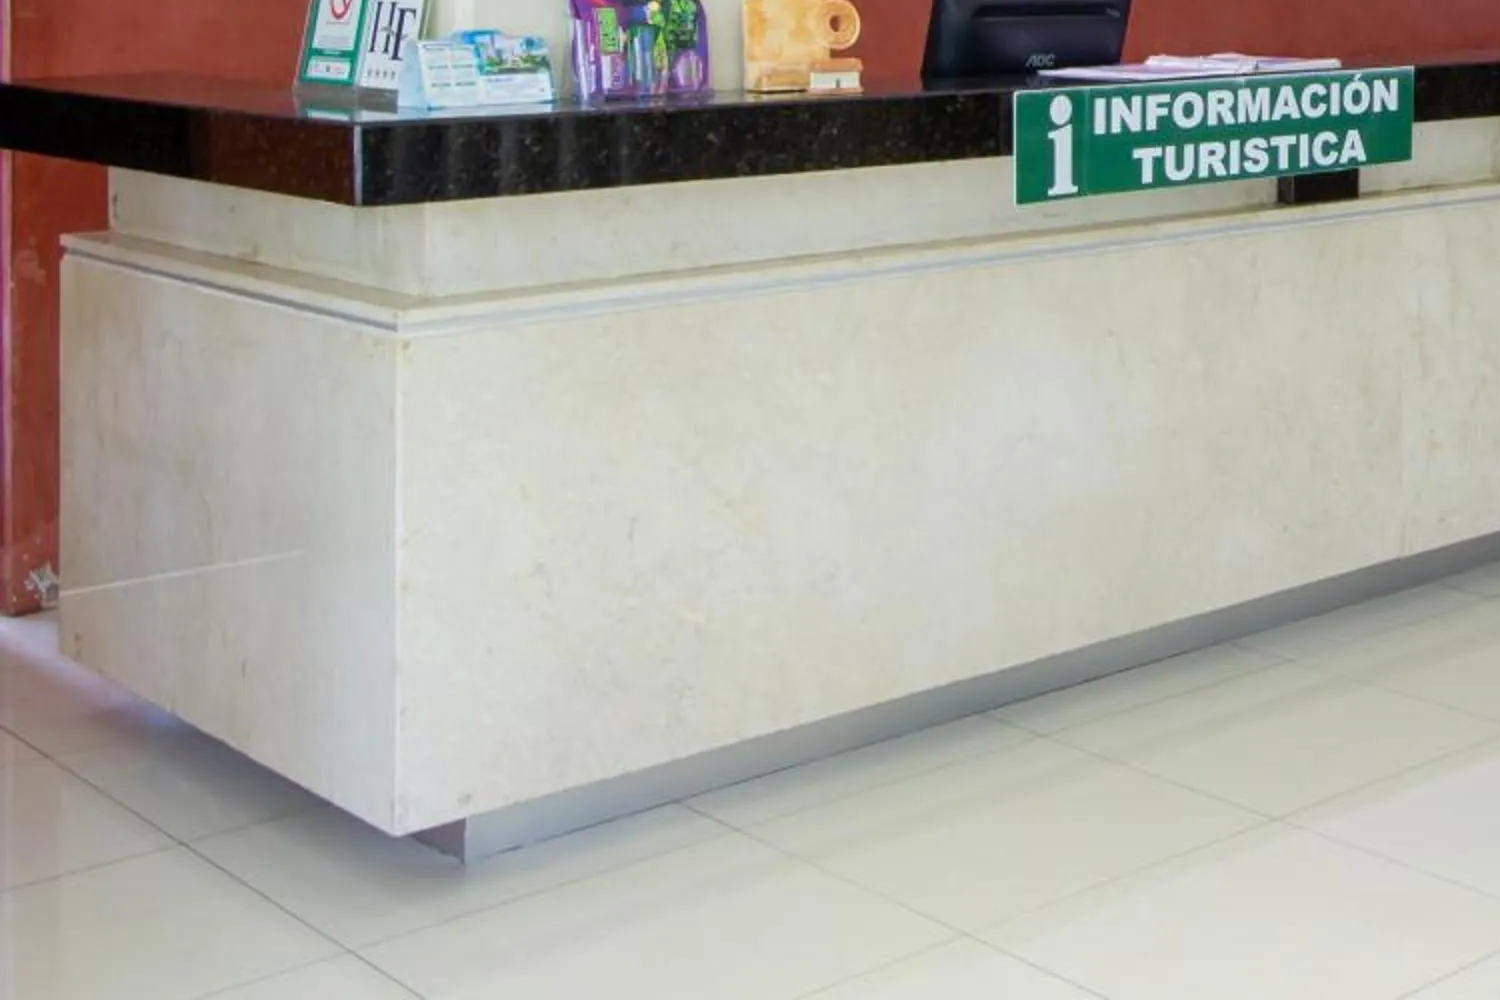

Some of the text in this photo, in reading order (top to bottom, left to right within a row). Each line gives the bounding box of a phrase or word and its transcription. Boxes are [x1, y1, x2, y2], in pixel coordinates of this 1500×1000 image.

[1025, 53, 1056, 69] AOC
[1093, 74, 1399, 135] INFORMACIÓN
[1132, 129, 1366, 185] TURISTICA
